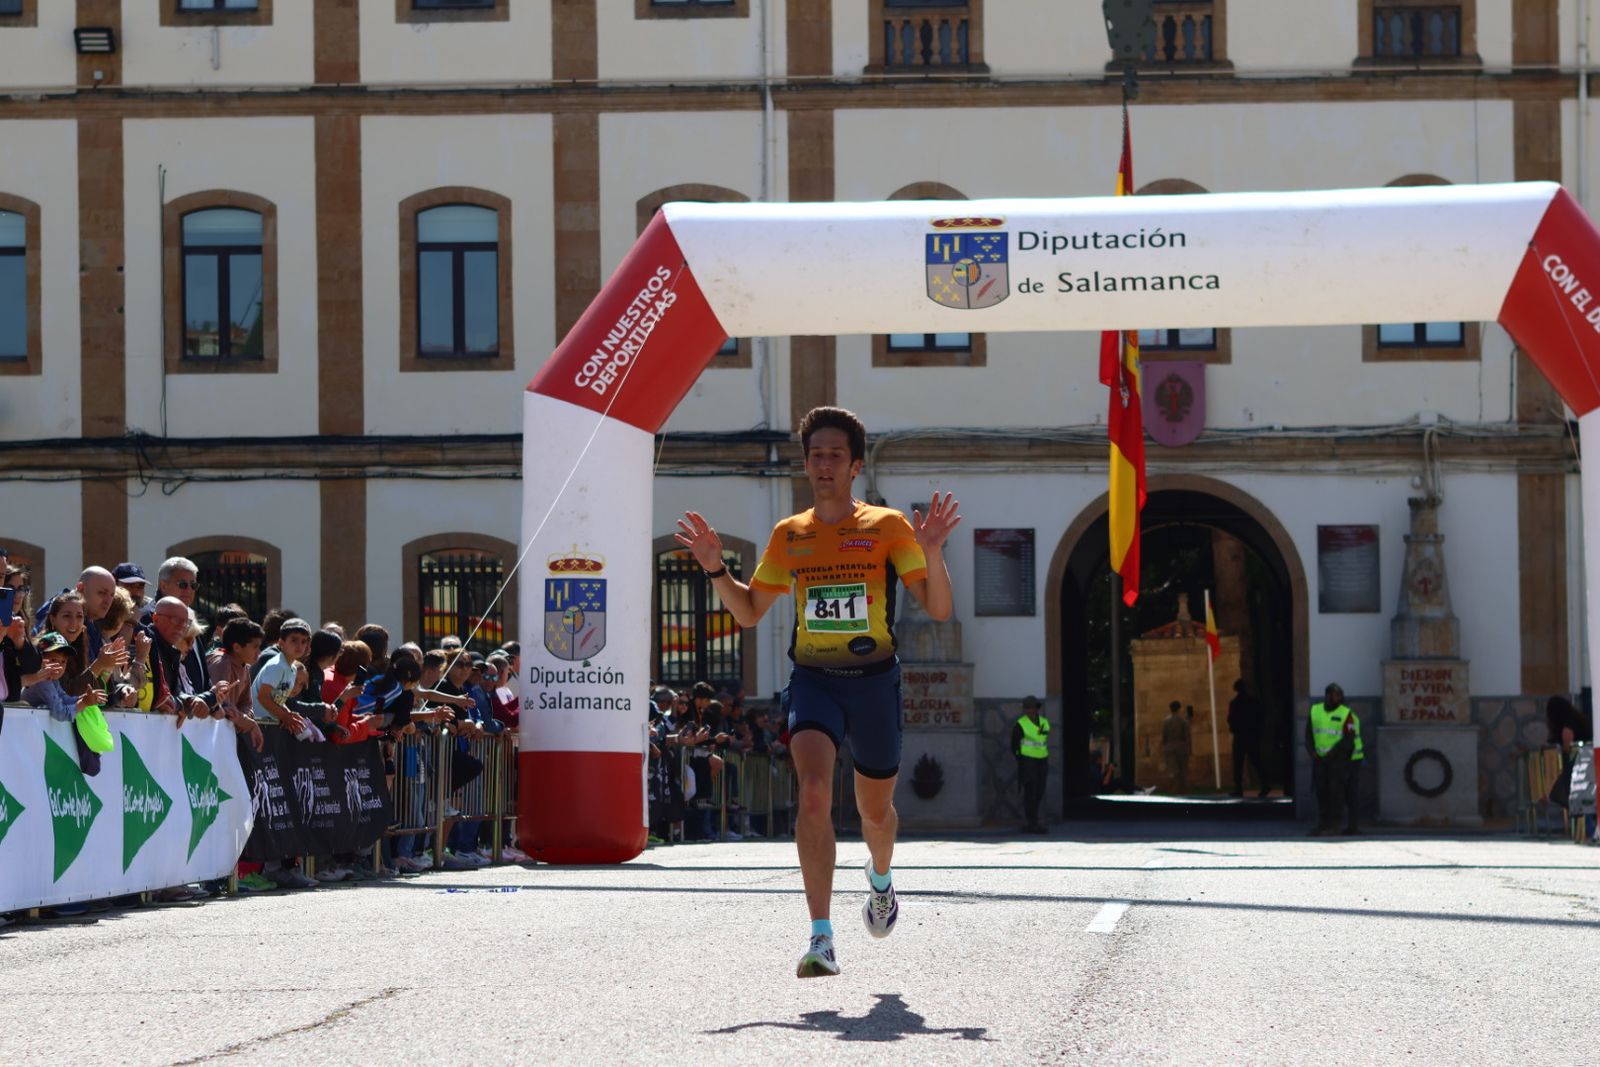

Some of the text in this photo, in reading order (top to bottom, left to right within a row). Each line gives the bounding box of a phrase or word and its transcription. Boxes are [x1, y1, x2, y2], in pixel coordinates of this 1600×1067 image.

[1018, 228, 1186, 255] Diputación
[1018, 271, 1220, 293] de Salamanca
[1543, 255, 1580, 294] CON
[1570, 288, 1592, 313] EL
[575, 266, 671, 387] CON NUESTROS
[591, 289, 677, 395] DEPORTISTAS
[797, 565, 833, 575] ESCUELA
[806, 572, 865, 582] SALMANTINA
[530, 666, 624, 687] Diputación
[903, 671, 948, 683] HONOR
[1401, 669, 1453, 681] DIERON
[524, 691, 631, 711] de Salamanca
[903, 699, 951, 711] GLORIA
[903, 711, 929, 723] LOS
[1400, 705, 1456, 720] ESPAÑA
